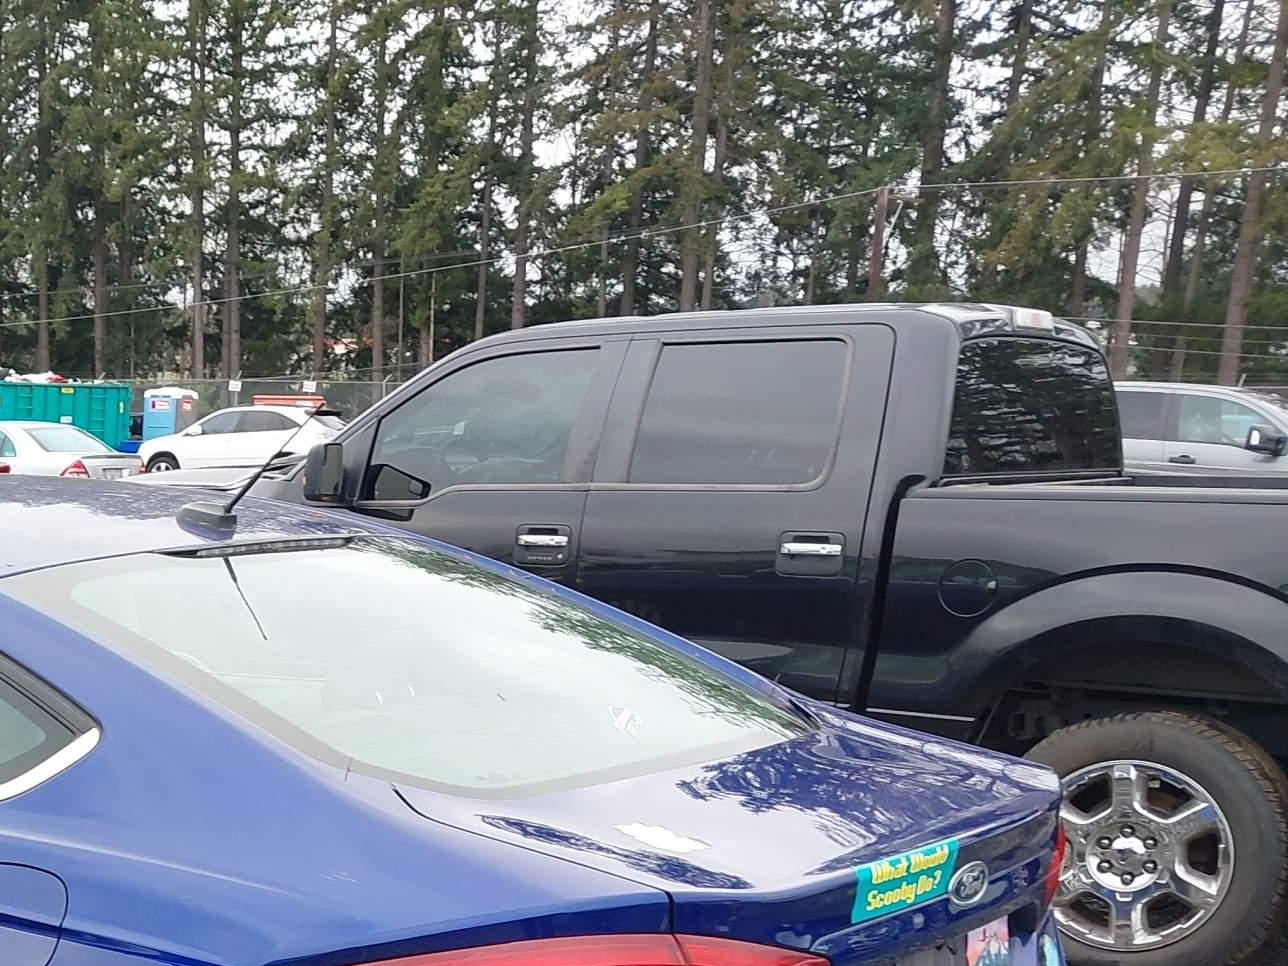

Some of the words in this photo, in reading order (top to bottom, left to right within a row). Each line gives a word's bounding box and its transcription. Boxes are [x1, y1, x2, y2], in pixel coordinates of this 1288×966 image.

[870, 856, 909, 886] What
[909, 843, 950, 873] Would
[866, 881, 917, 912] Scooby
[916, 869, 942, 896] Do?
